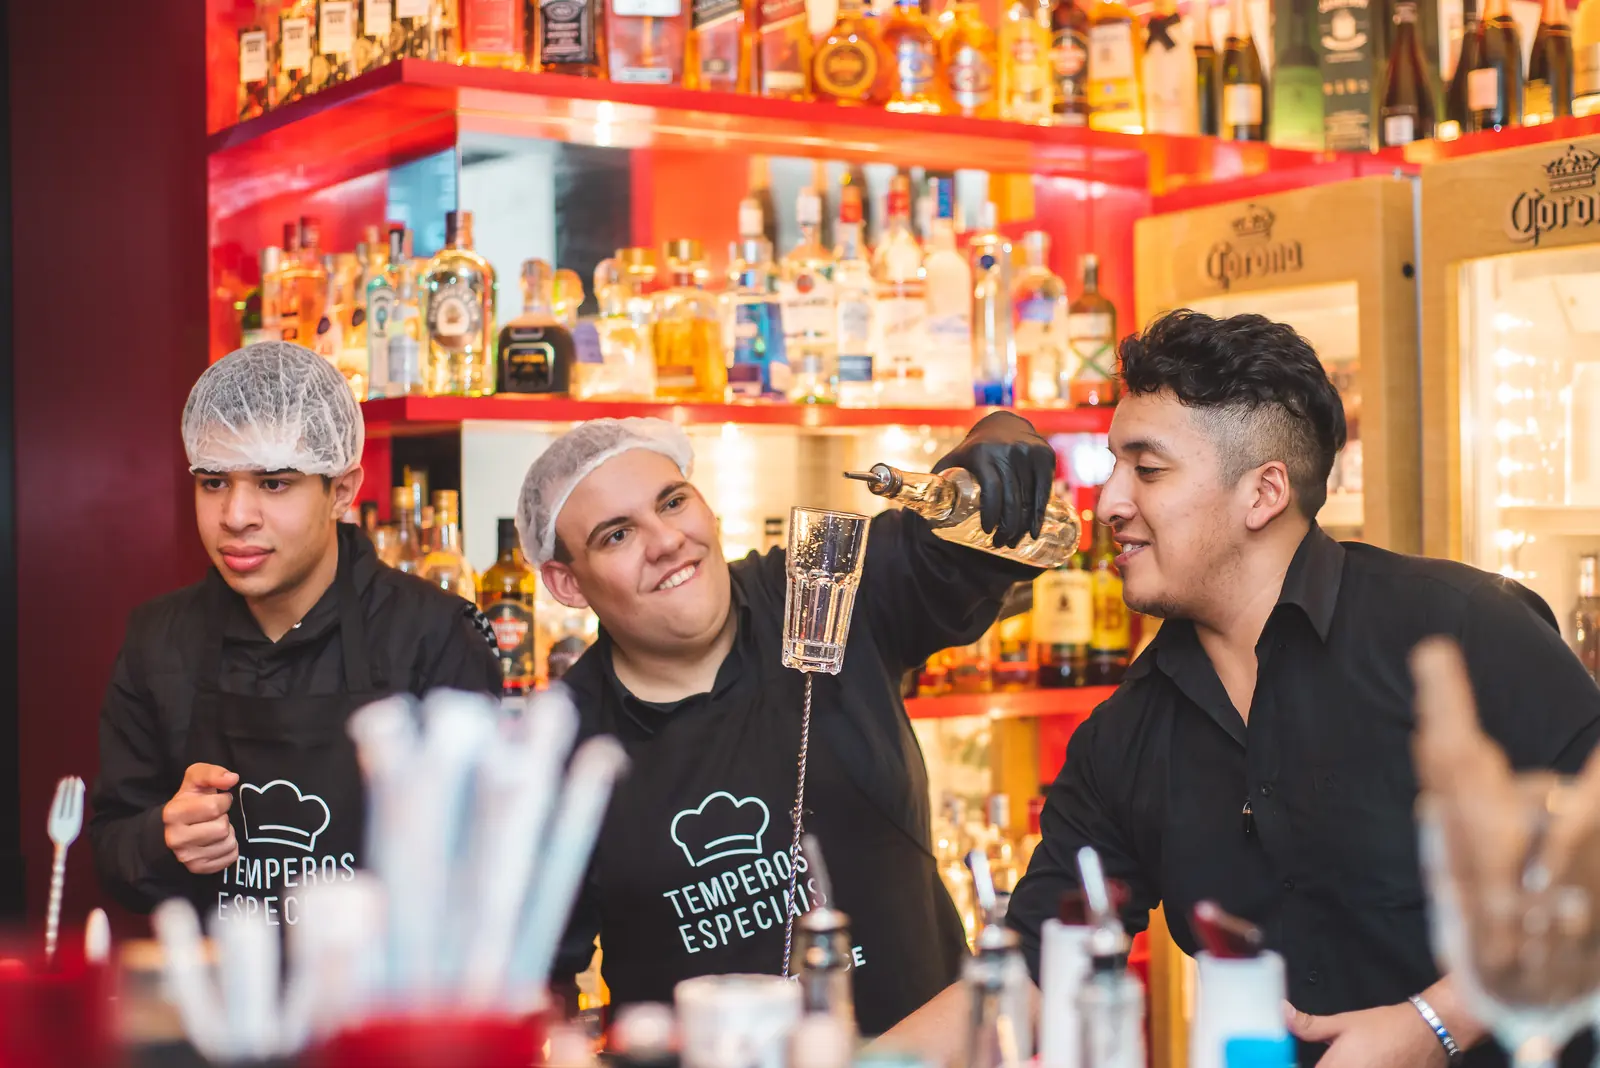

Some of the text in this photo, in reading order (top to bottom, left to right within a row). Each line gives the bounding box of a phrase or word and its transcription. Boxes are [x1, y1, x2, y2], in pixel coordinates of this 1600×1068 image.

[1508, 188, 1600, 246] Coro
[1205, 241, 1303, 291] Corona
[663, 844, 808, 918] TEMPEROS
[217, 891, 300, 926] ESPEC
